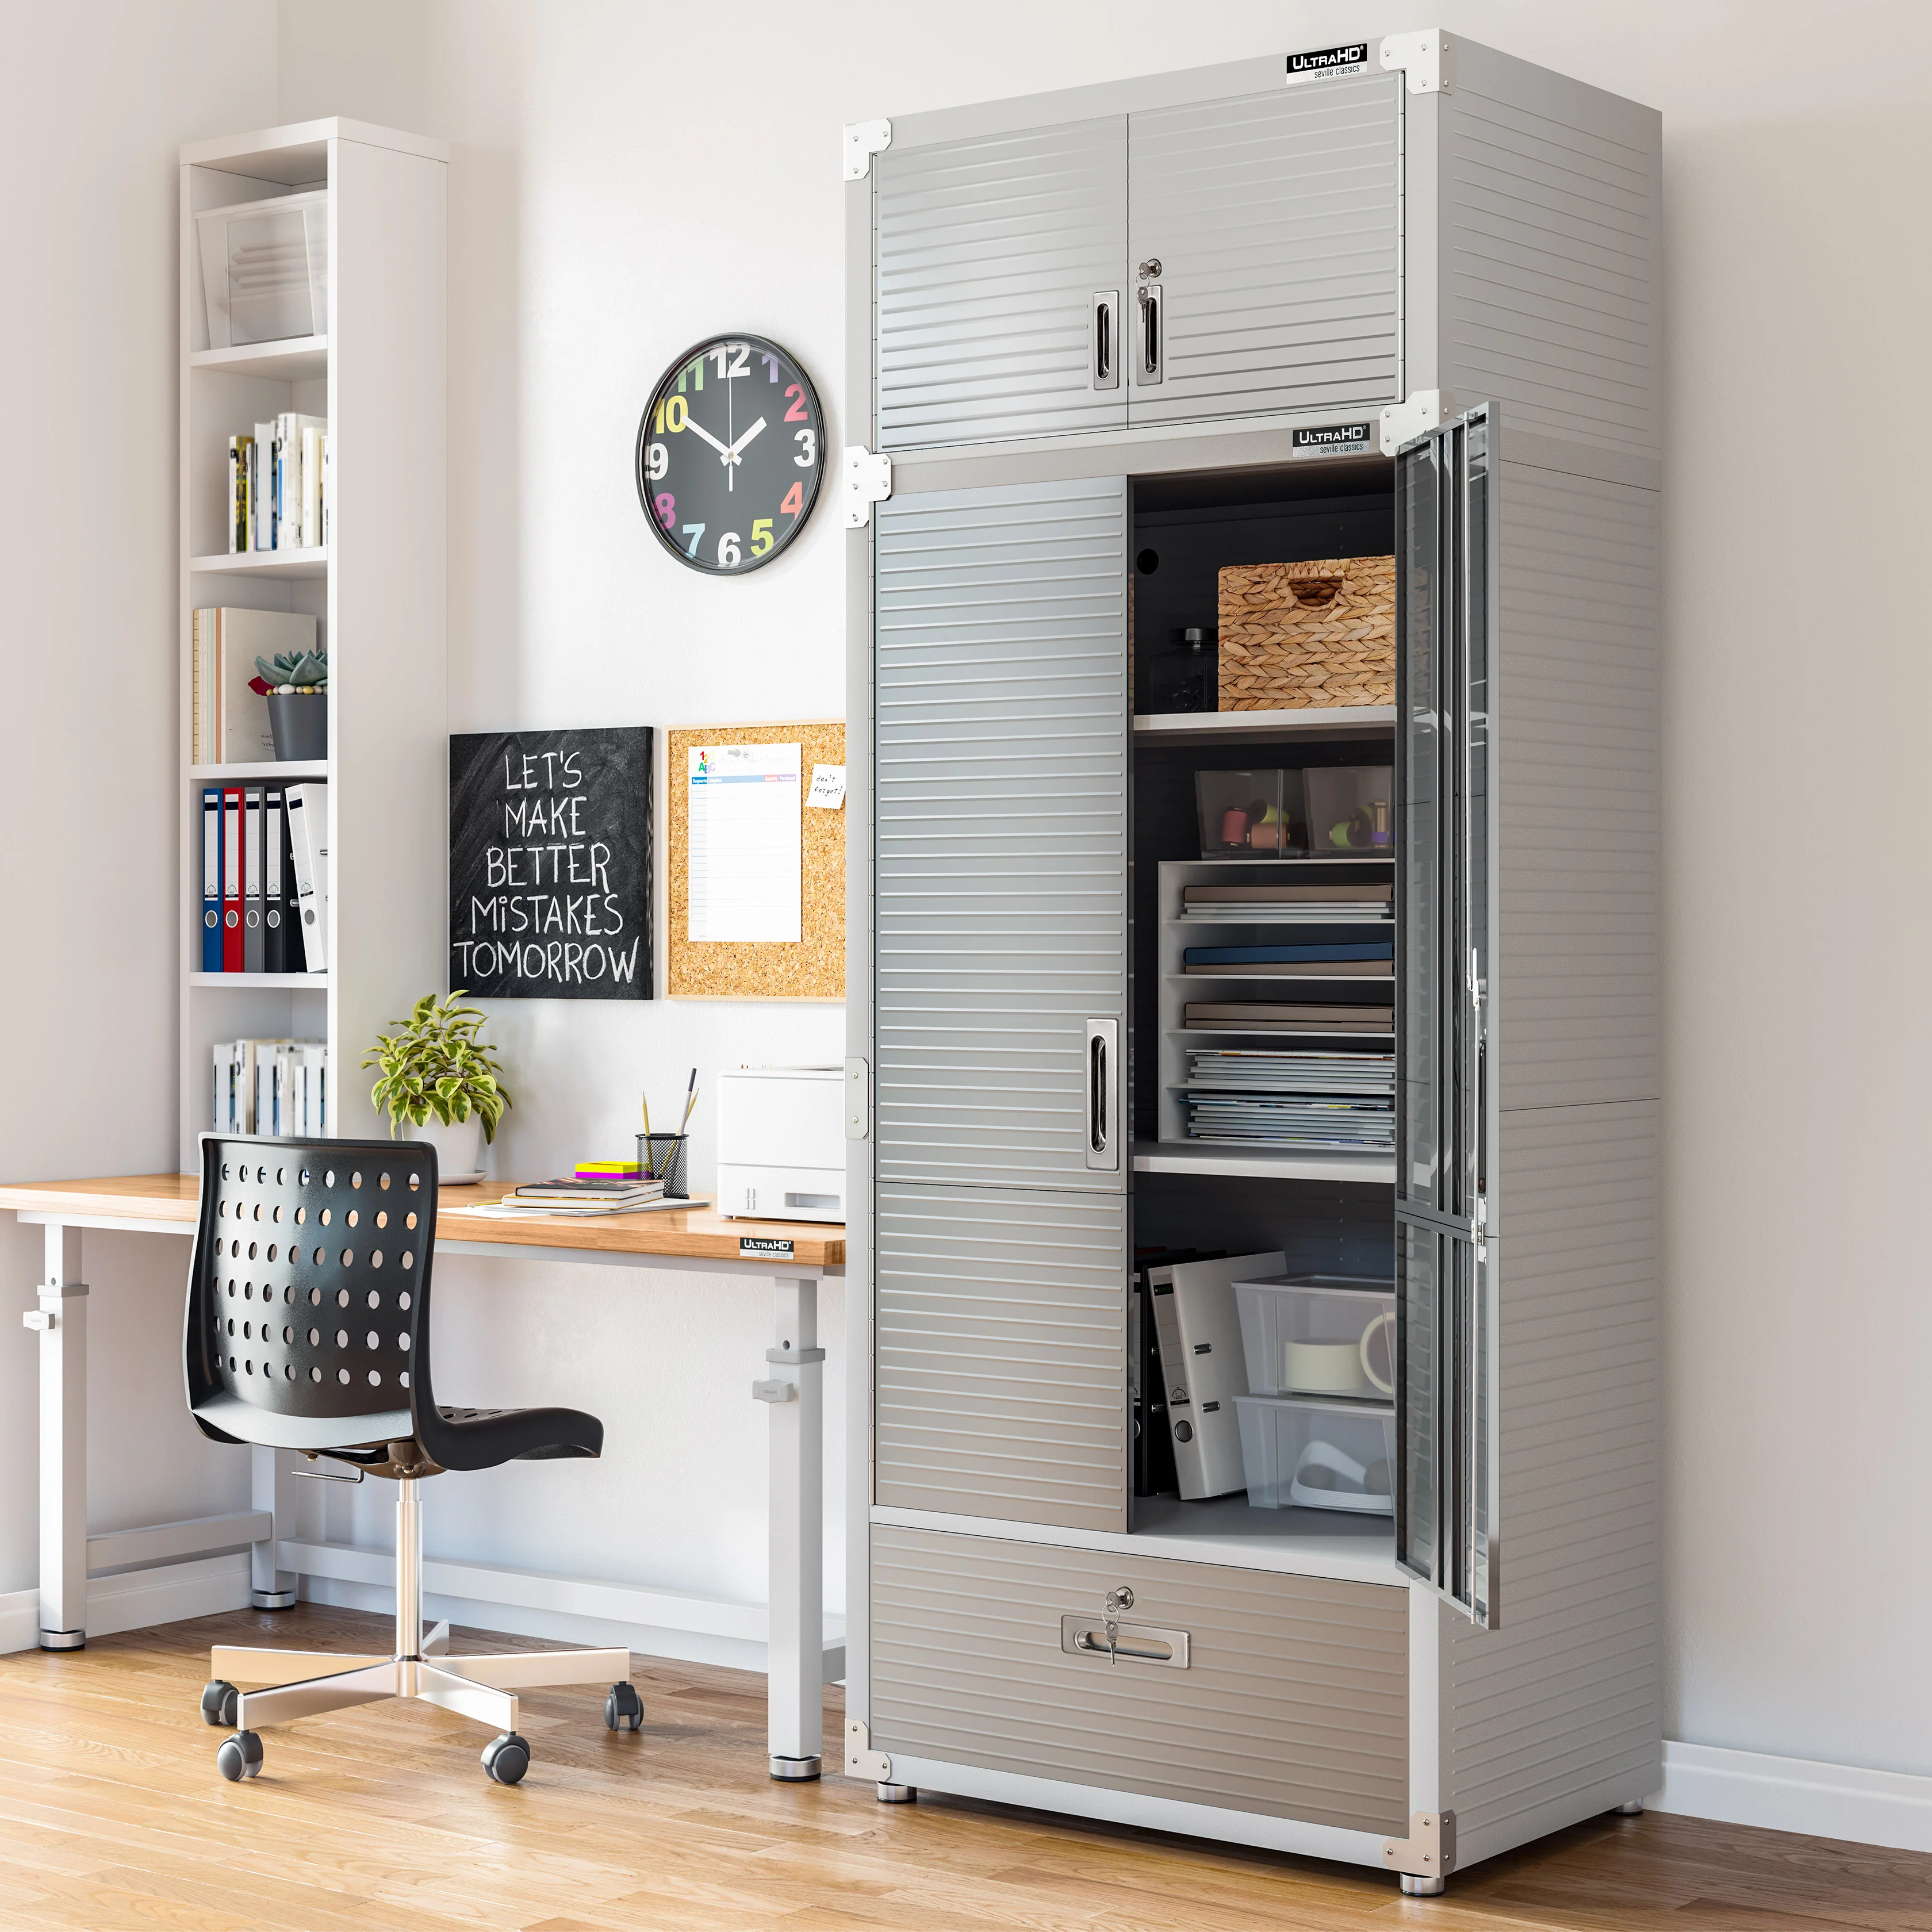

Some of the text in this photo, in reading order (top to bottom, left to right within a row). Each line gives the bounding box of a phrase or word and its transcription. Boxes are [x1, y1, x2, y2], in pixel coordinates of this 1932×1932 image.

[1314, 64, 1360, 79] seville classics
[710, 345, 750, 379] 12
[762, 353, 778, 383] 1
[653, 395, 688, 434] 10
[784, 384, 808, 422] 2
[645, 443, 669, 480] 9
[793, 429, 815, 467] 3
[1340, 443, 1363, 452] classics
[653, 493, 676, 530] 8
[780, 481, 803, 520] 4
[683, 523, 706, 558] 7
[717, 532, 741, 567] 6
[750, 518, 774, 558] 5
[505, 750, 582, 789] LET'S
[505, 796, 587, 838] MAKE
[486, 842, 611, 894] BETTER
[453, 936, 640, 984] TOMORROW
